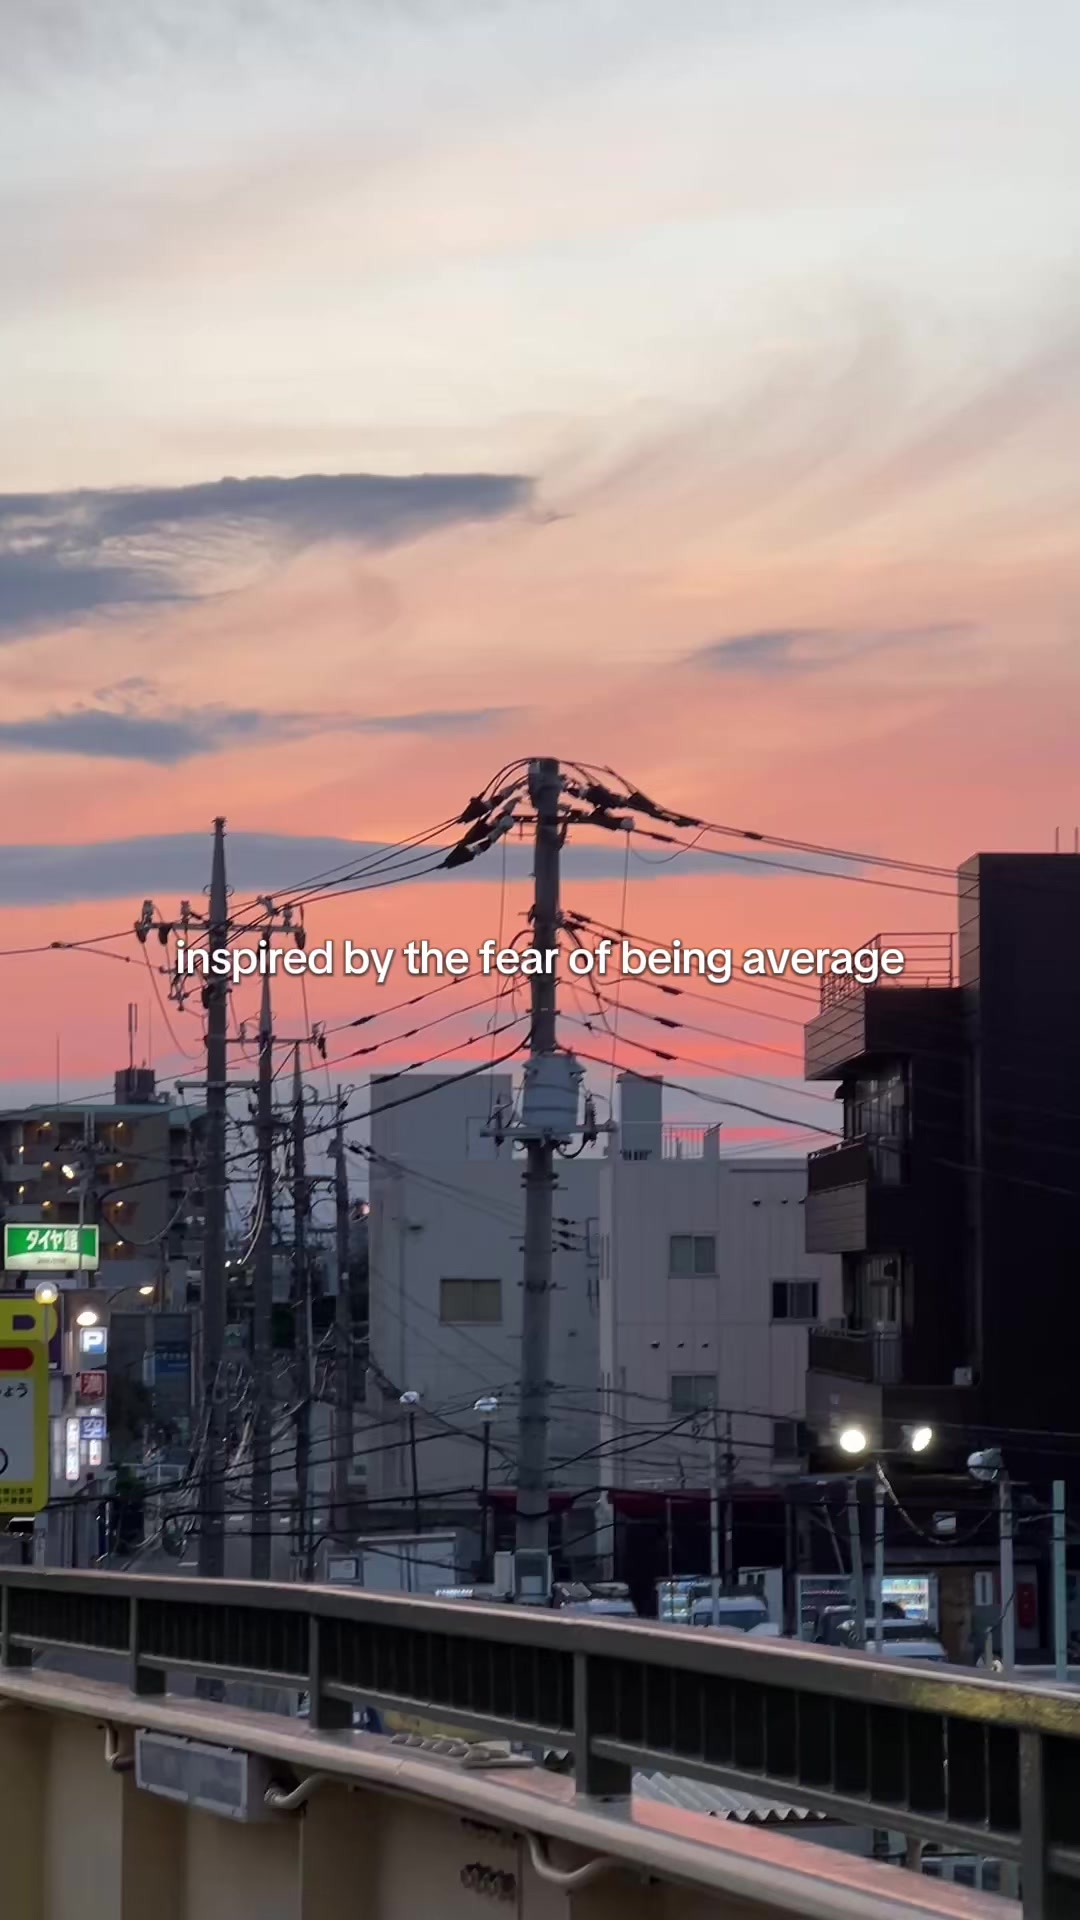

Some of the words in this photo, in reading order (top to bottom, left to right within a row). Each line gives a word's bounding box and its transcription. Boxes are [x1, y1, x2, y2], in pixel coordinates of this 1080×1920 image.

[25, 1229, 79, 1251] タイヤ館
[83, 1330, 104, 1352] P
[83, 1418, 103, 1437] 空
